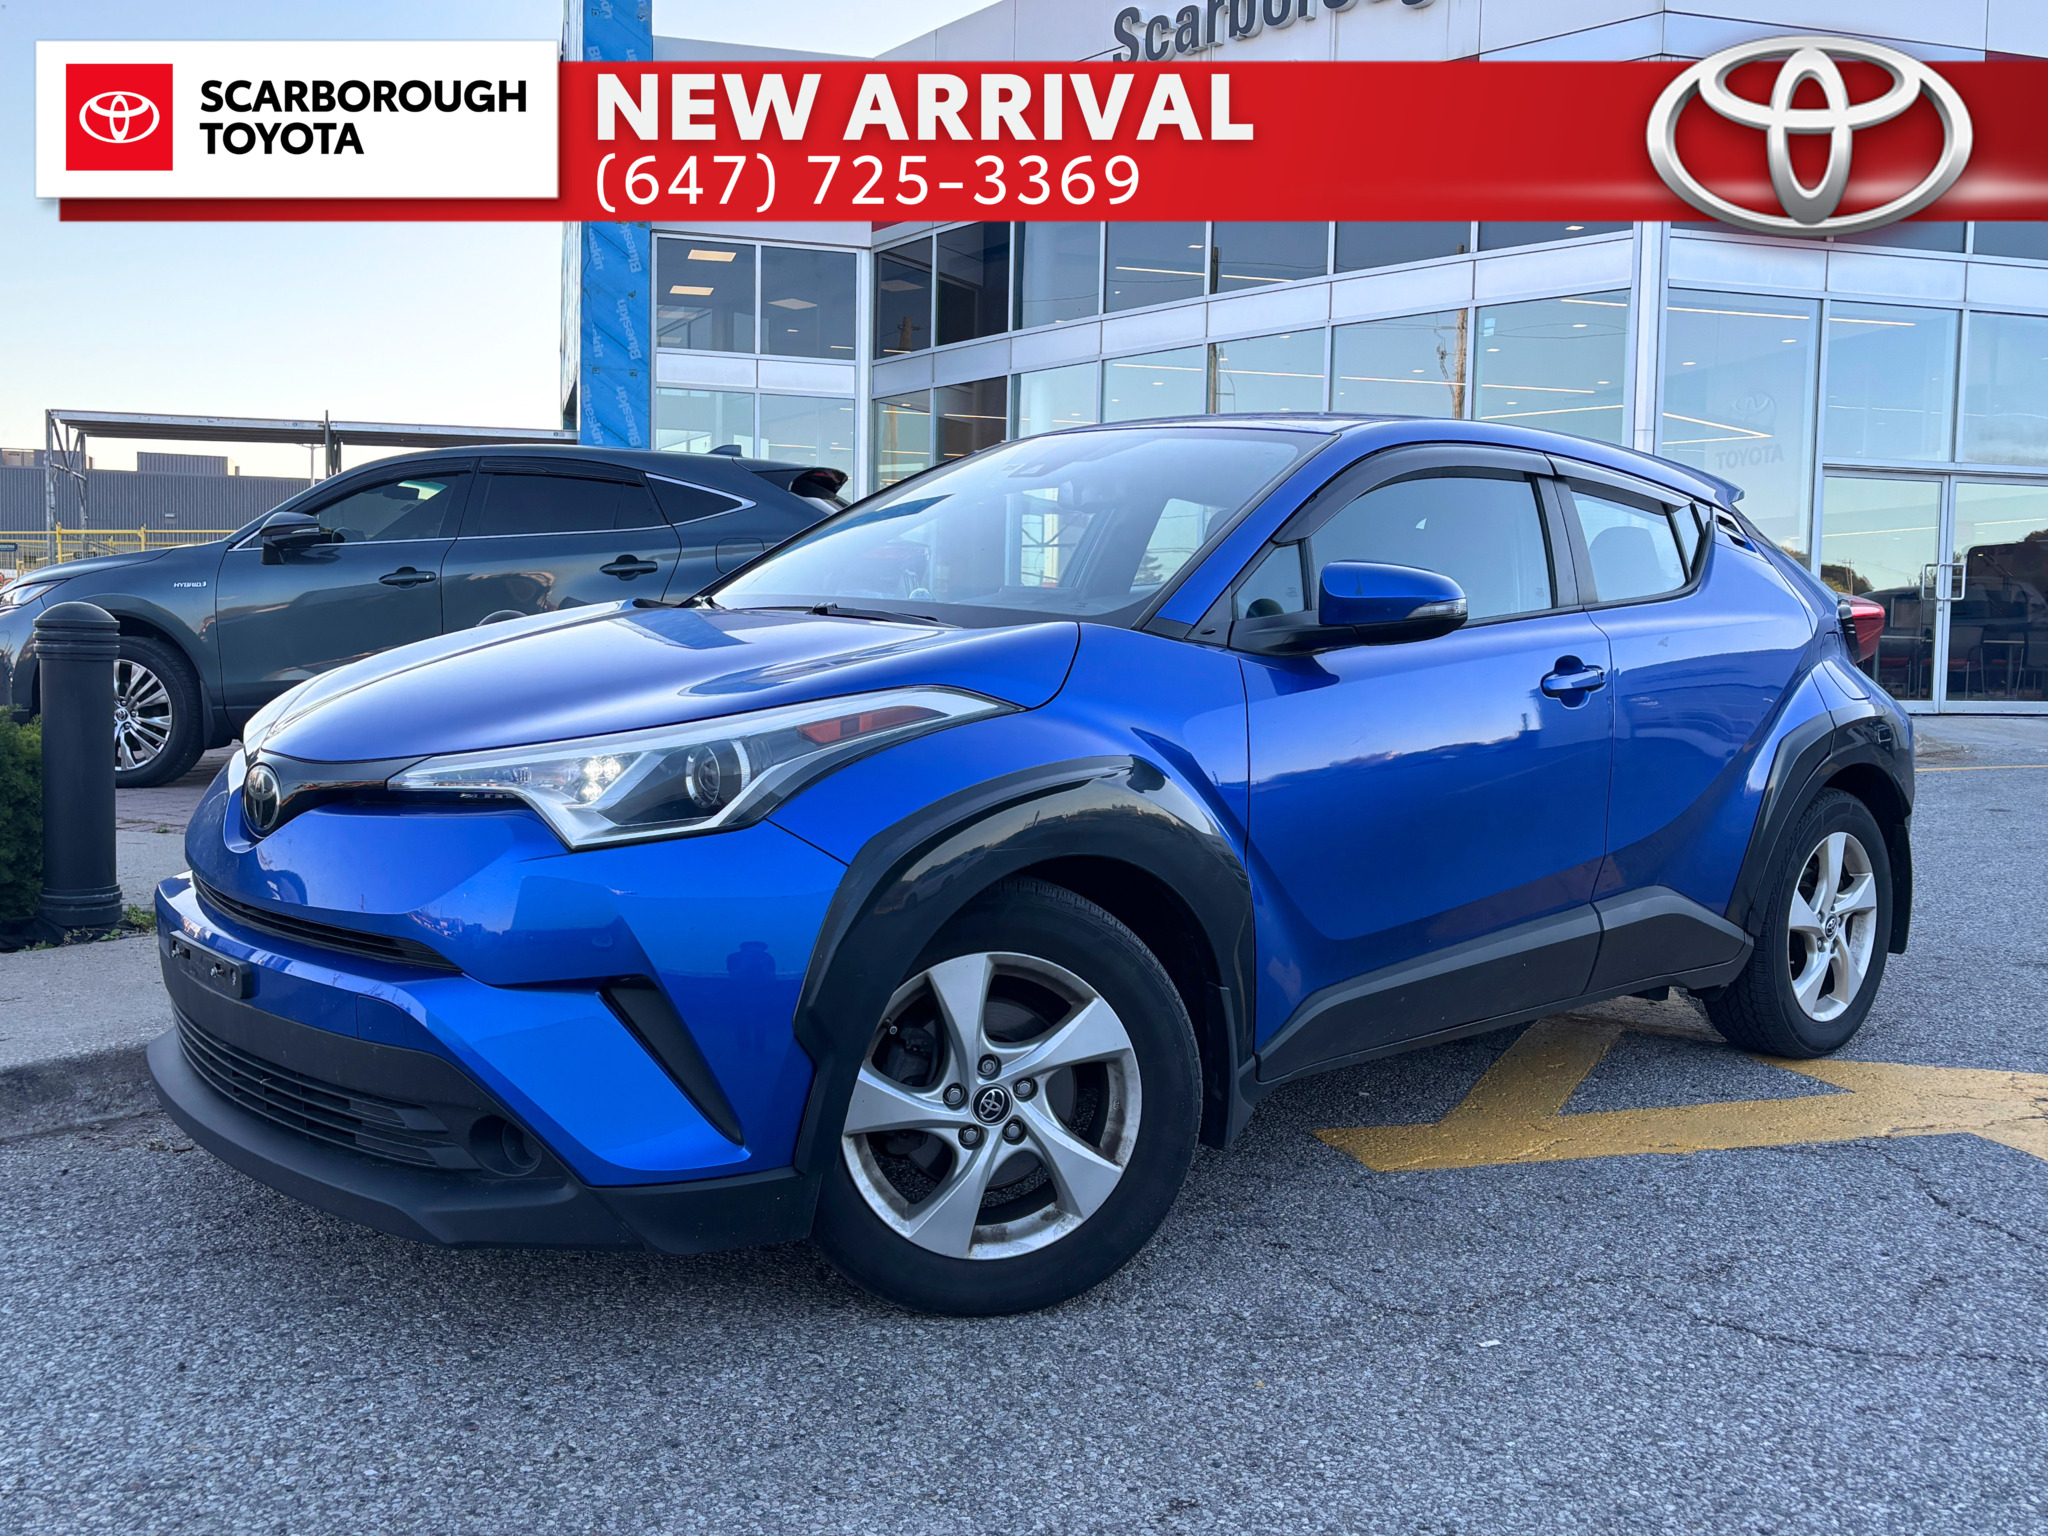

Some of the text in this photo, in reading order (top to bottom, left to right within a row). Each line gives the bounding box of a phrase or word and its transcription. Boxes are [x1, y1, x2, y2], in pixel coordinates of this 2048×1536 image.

[616, 299, 642, 360] Blueskin
[581, 384, 604, 445] Blueskin
[616, 385, 642, 447] Blueskin
[1715, 443, 1784, 470] TOYOTA
